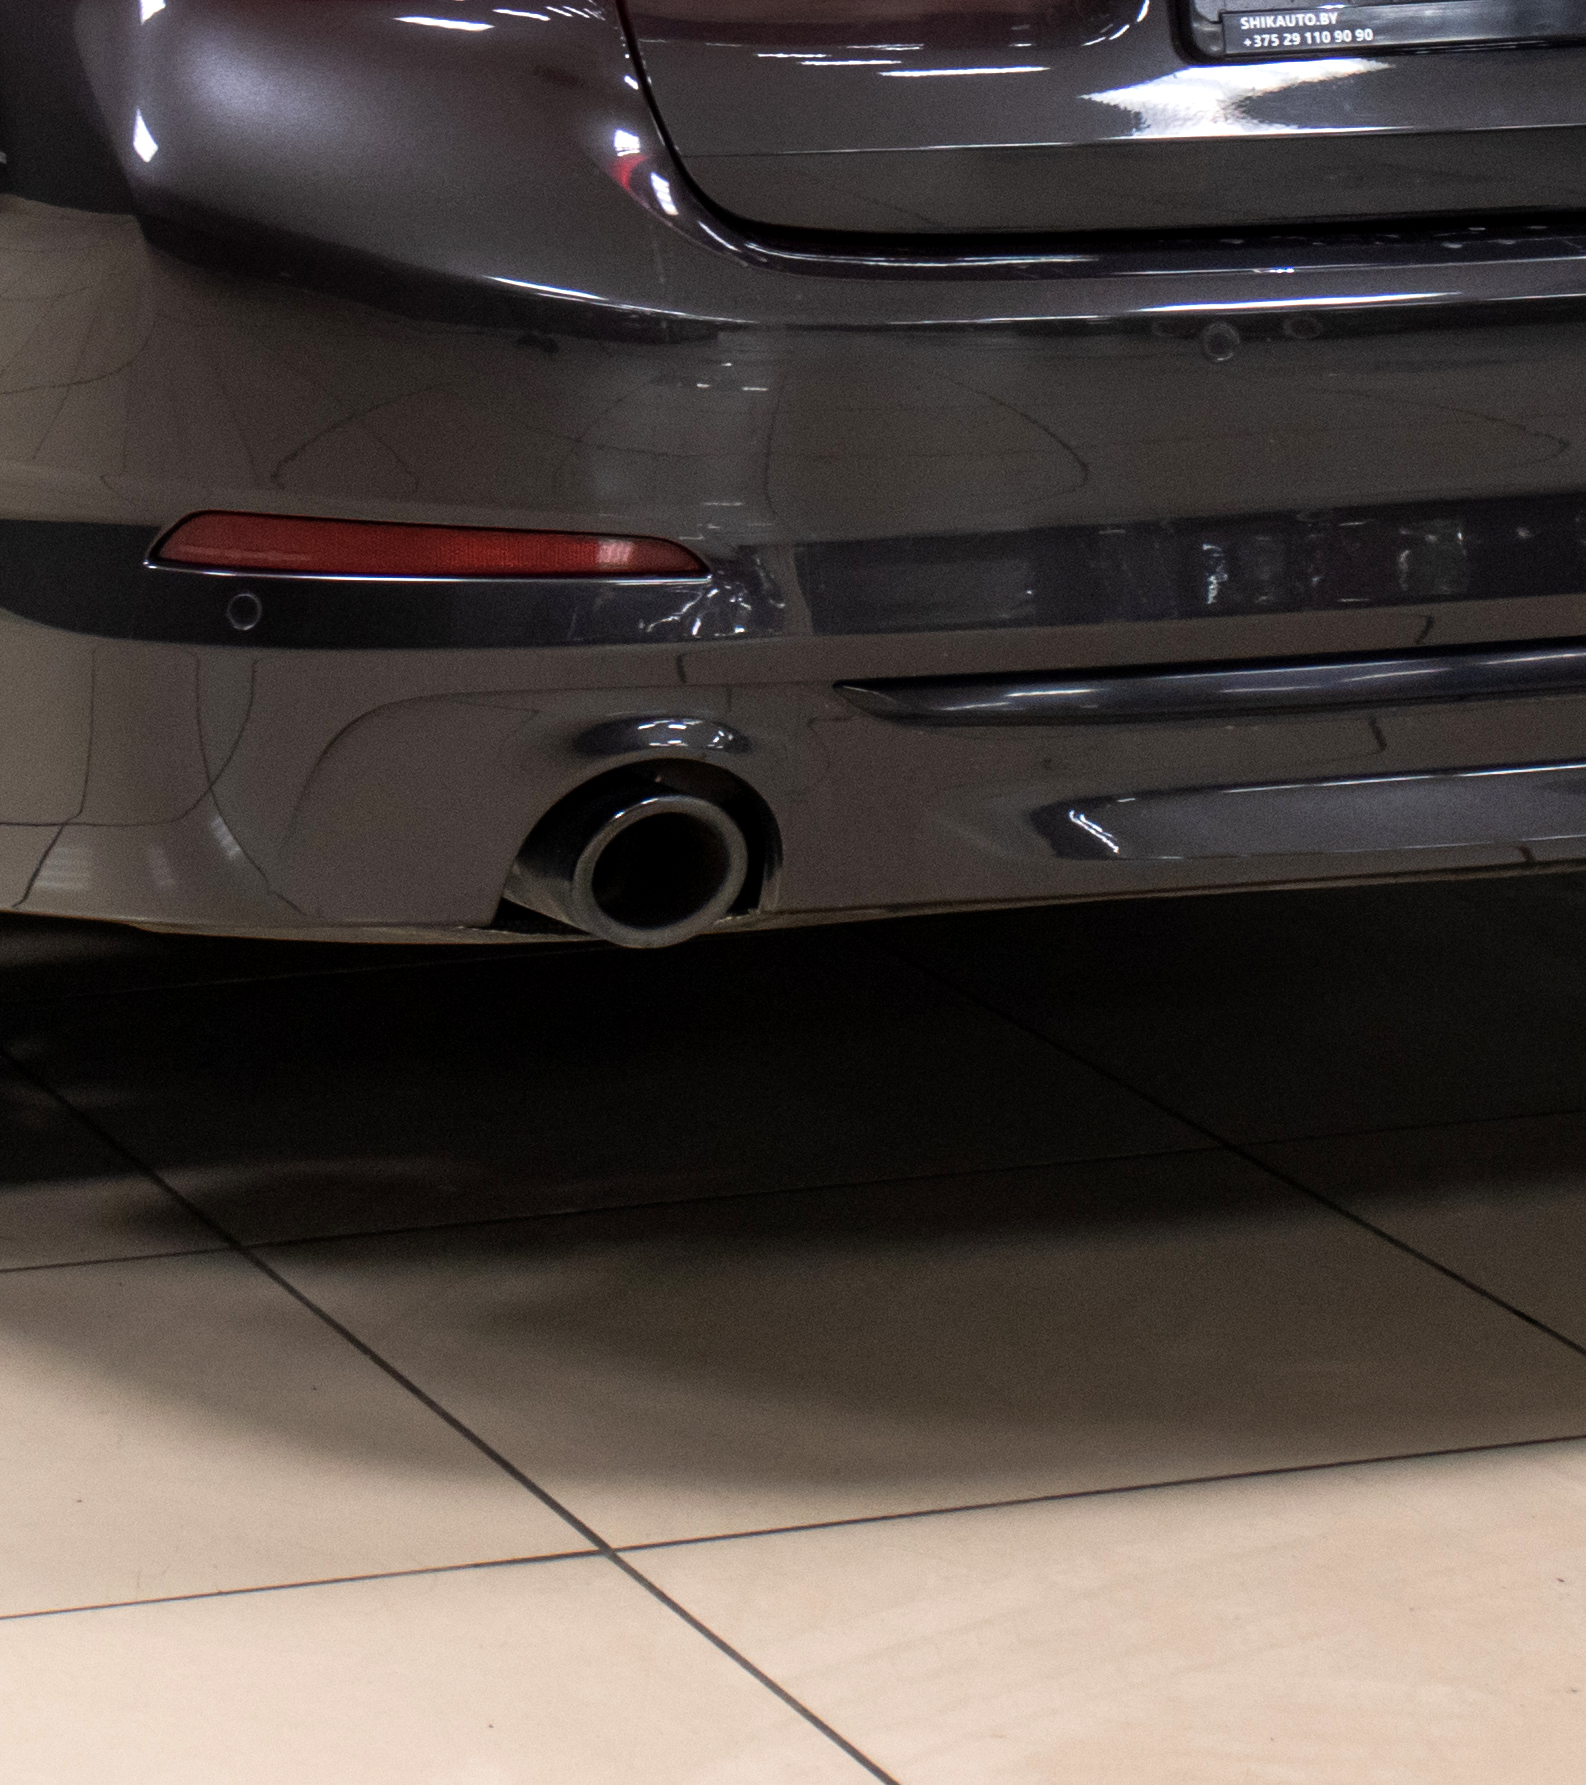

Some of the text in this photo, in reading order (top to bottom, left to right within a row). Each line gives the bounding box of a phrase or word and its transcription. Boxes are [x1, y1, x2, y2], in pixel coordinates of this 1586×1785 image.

[1240, 12, 1339, 30] SHIKAUTO.BY
[1243, 28, 1374, 48] +375 29 110 90 90
